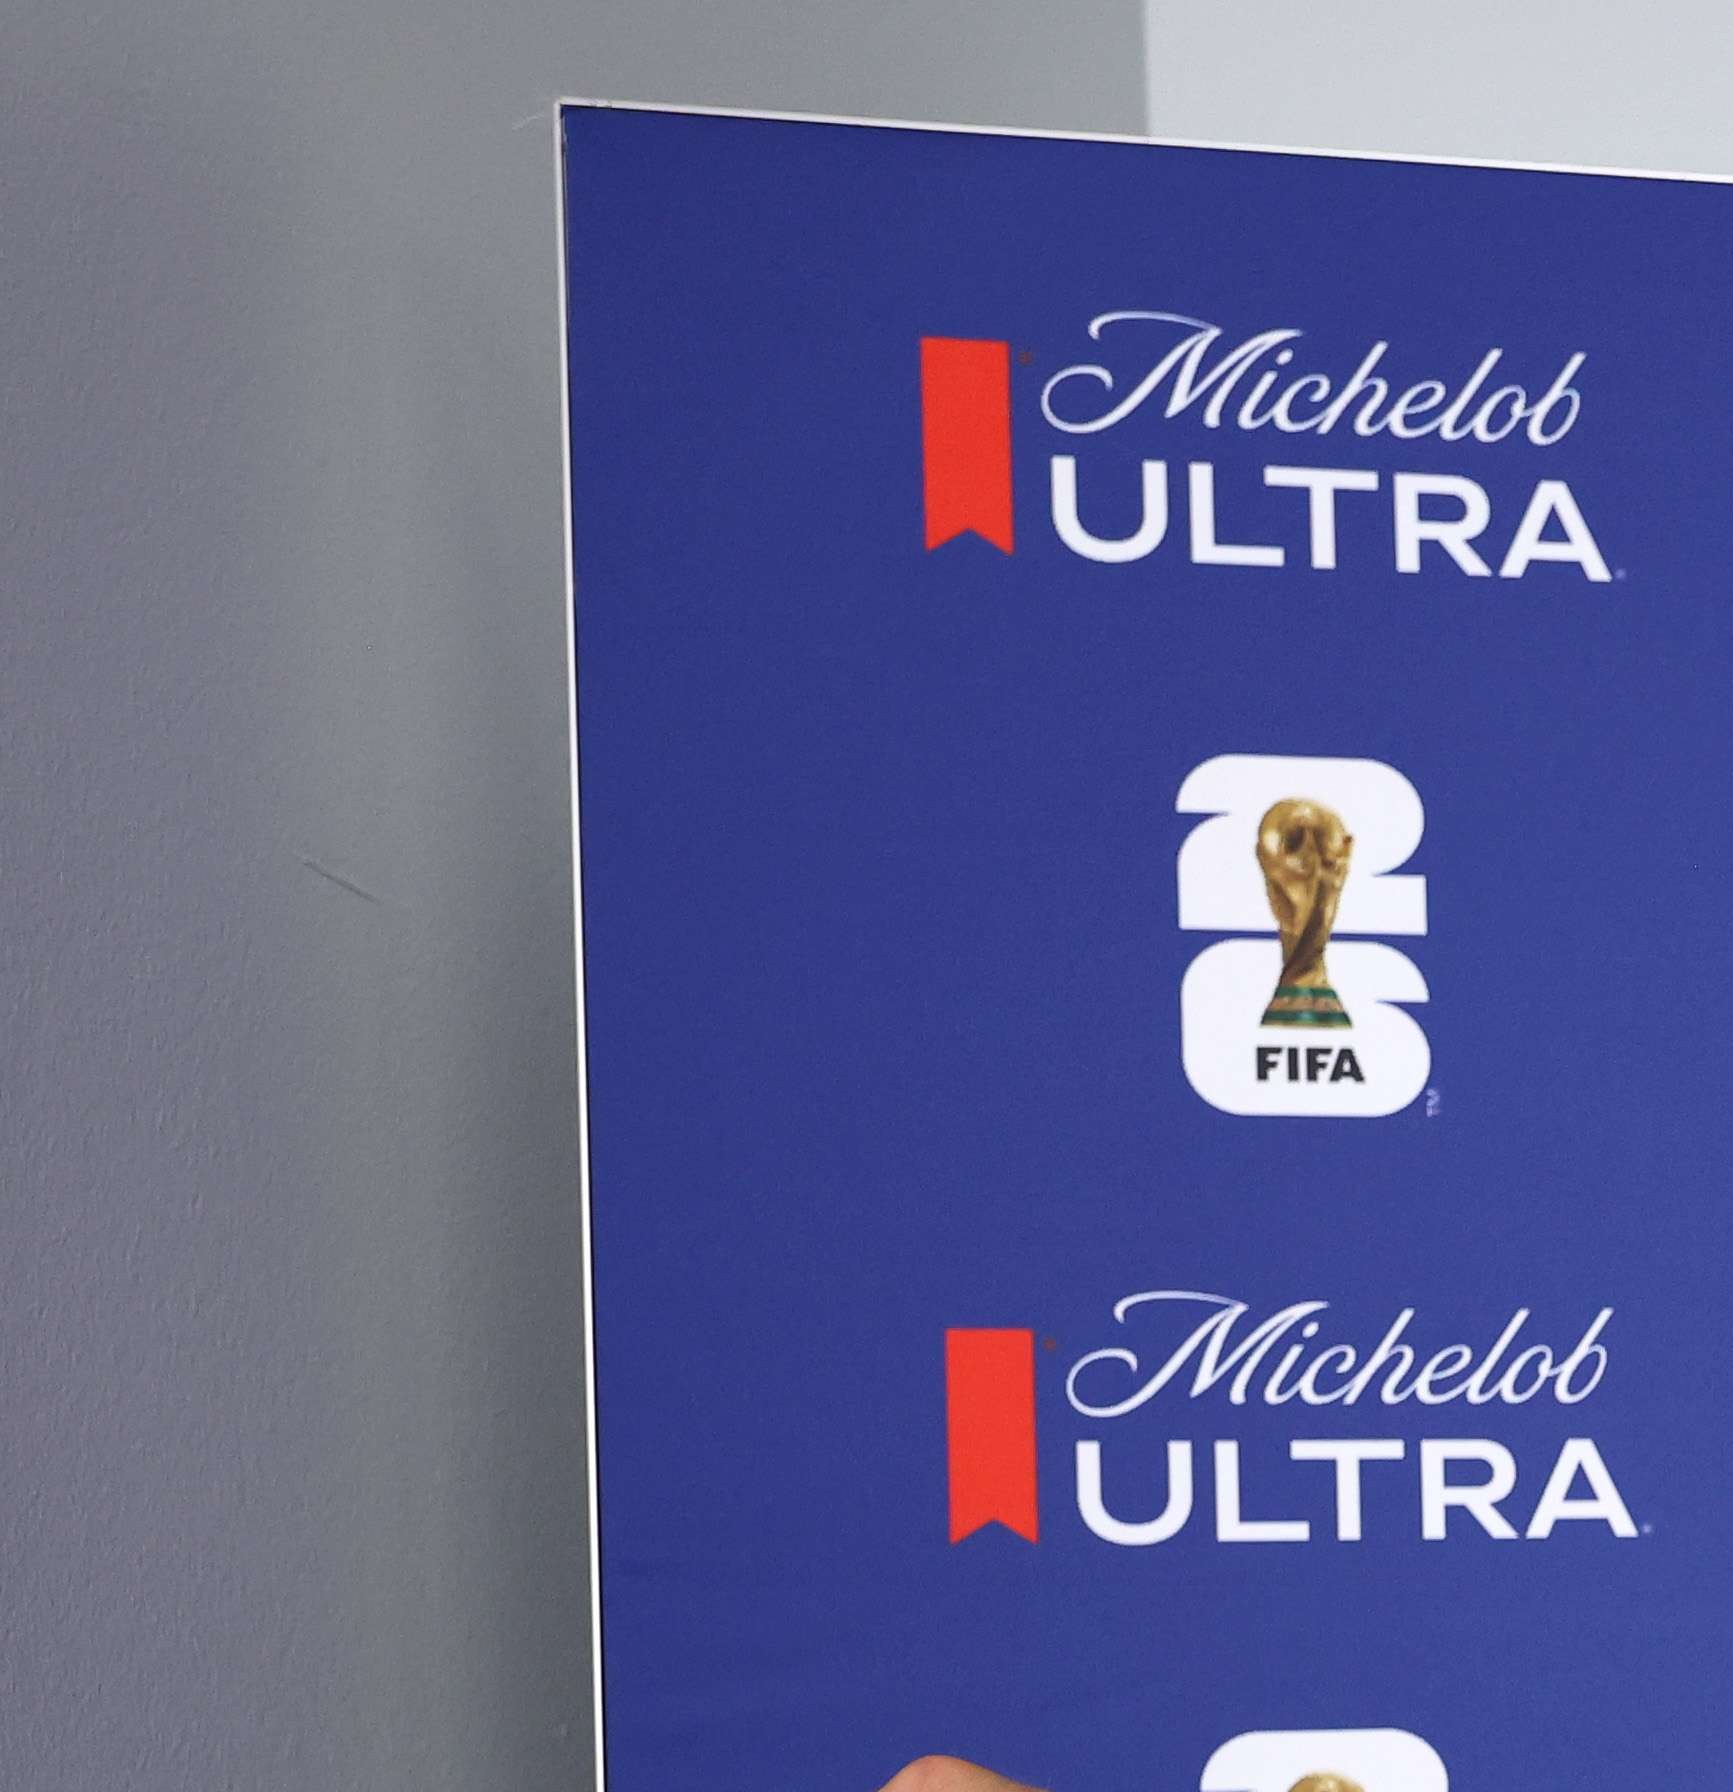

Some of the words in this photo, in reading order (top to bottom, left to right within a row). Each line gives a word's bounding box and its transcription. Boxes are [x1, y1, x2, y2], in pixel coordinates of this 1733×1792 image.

[1041, 310, 1586, 446] Michelob
[1050, 455, 1612, 583] ULTRA
[1256, 1046, 1365, 1083] FIFA
[1066, 1290, 1614, 1418] Michelob
[1075, 1438, 1638, 1546] ULTRA
